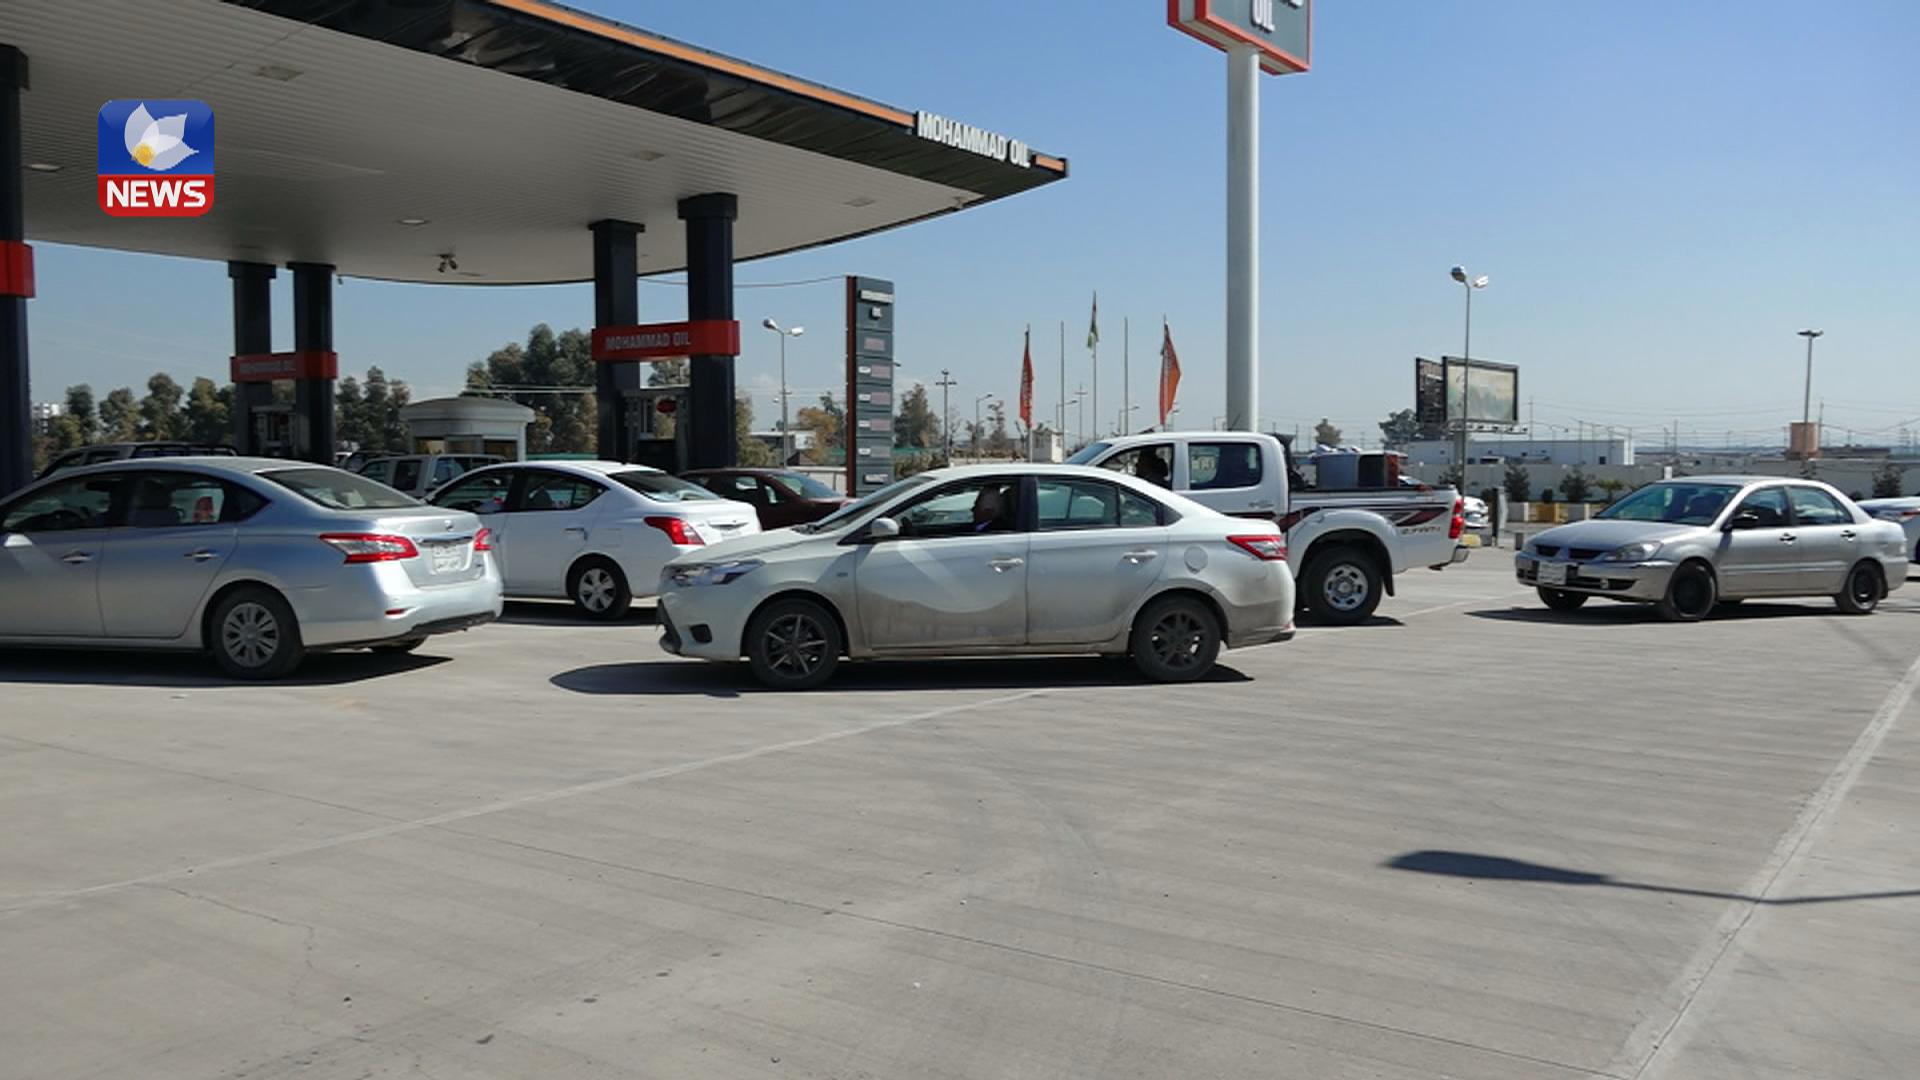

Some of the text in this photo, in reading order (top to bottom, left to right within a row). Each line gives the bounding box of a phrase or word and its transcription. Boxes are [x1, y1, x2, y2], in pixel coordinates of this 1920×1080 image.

[918, 110, 1031, 169] MOHAMMAD OIL
[605, 332, 691, 350] MOHAMMAD OIL
